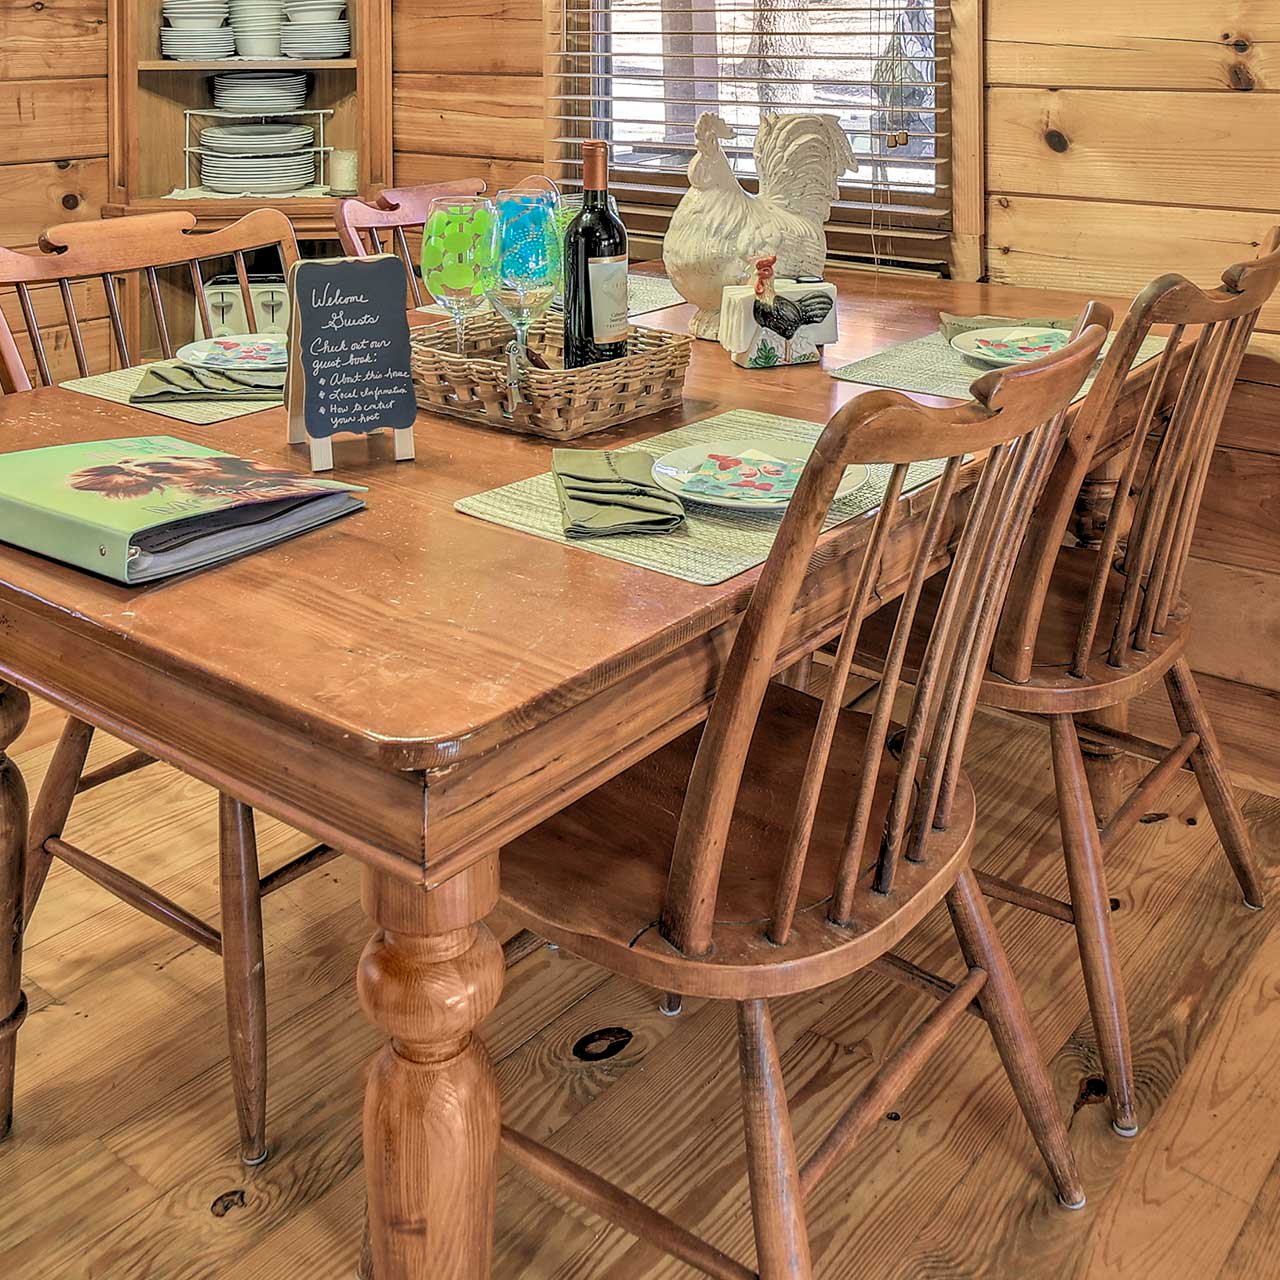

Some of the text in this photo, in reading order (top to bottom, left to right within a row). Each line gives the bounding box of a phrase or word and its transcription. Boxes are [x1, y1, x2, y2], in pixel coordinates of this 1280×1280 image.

[312, 282, 369, 308] Welcome
[321, 310, 380, 331] Guests
[310, 337, 391, 356] Check out our
[312, 357, 342, 376] guest
[329, 372, 362, 386] About
[362, 370, 383, 382] this
[328, 388, 359, 402] Local
[330, 399, 396, 414] How to contact
[330, 412, 381, 429] your host
